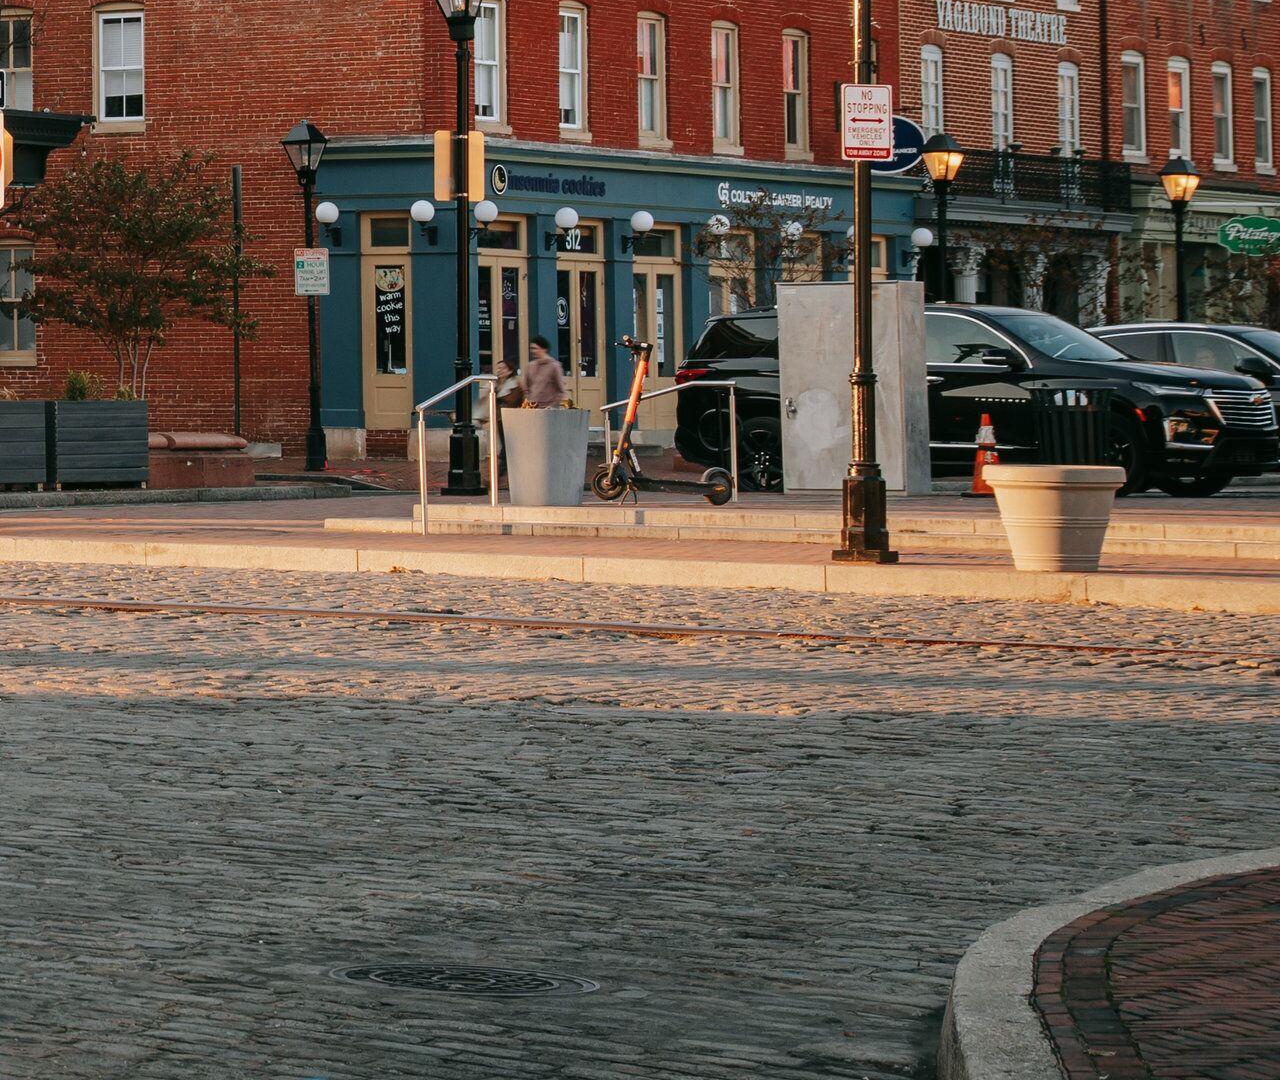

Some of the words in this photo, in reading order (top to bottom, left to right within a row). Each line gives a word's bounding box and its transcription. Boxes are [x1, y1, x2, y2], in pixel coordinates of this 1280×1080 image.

[1008, 7, 1067, 46] THEATRE
[861, 90, 873, 101] NO
[846, 102, 888, 114] STOPPING
[873, 149, 888, 157] ZONE
[507, 169, 560, 194] insomnia
[561, 174, 606, 198] cookies
[805, 195, 833, 209] REALTY
[565, 228, 581, 250] 312
[1225, 222, 1280, 244] Pitang
[379, 291, 401, 302] warm
[376, 301, 403, 313] cookie
[384, 313, 400, 323] this
[385, 324, 402, 334] way
